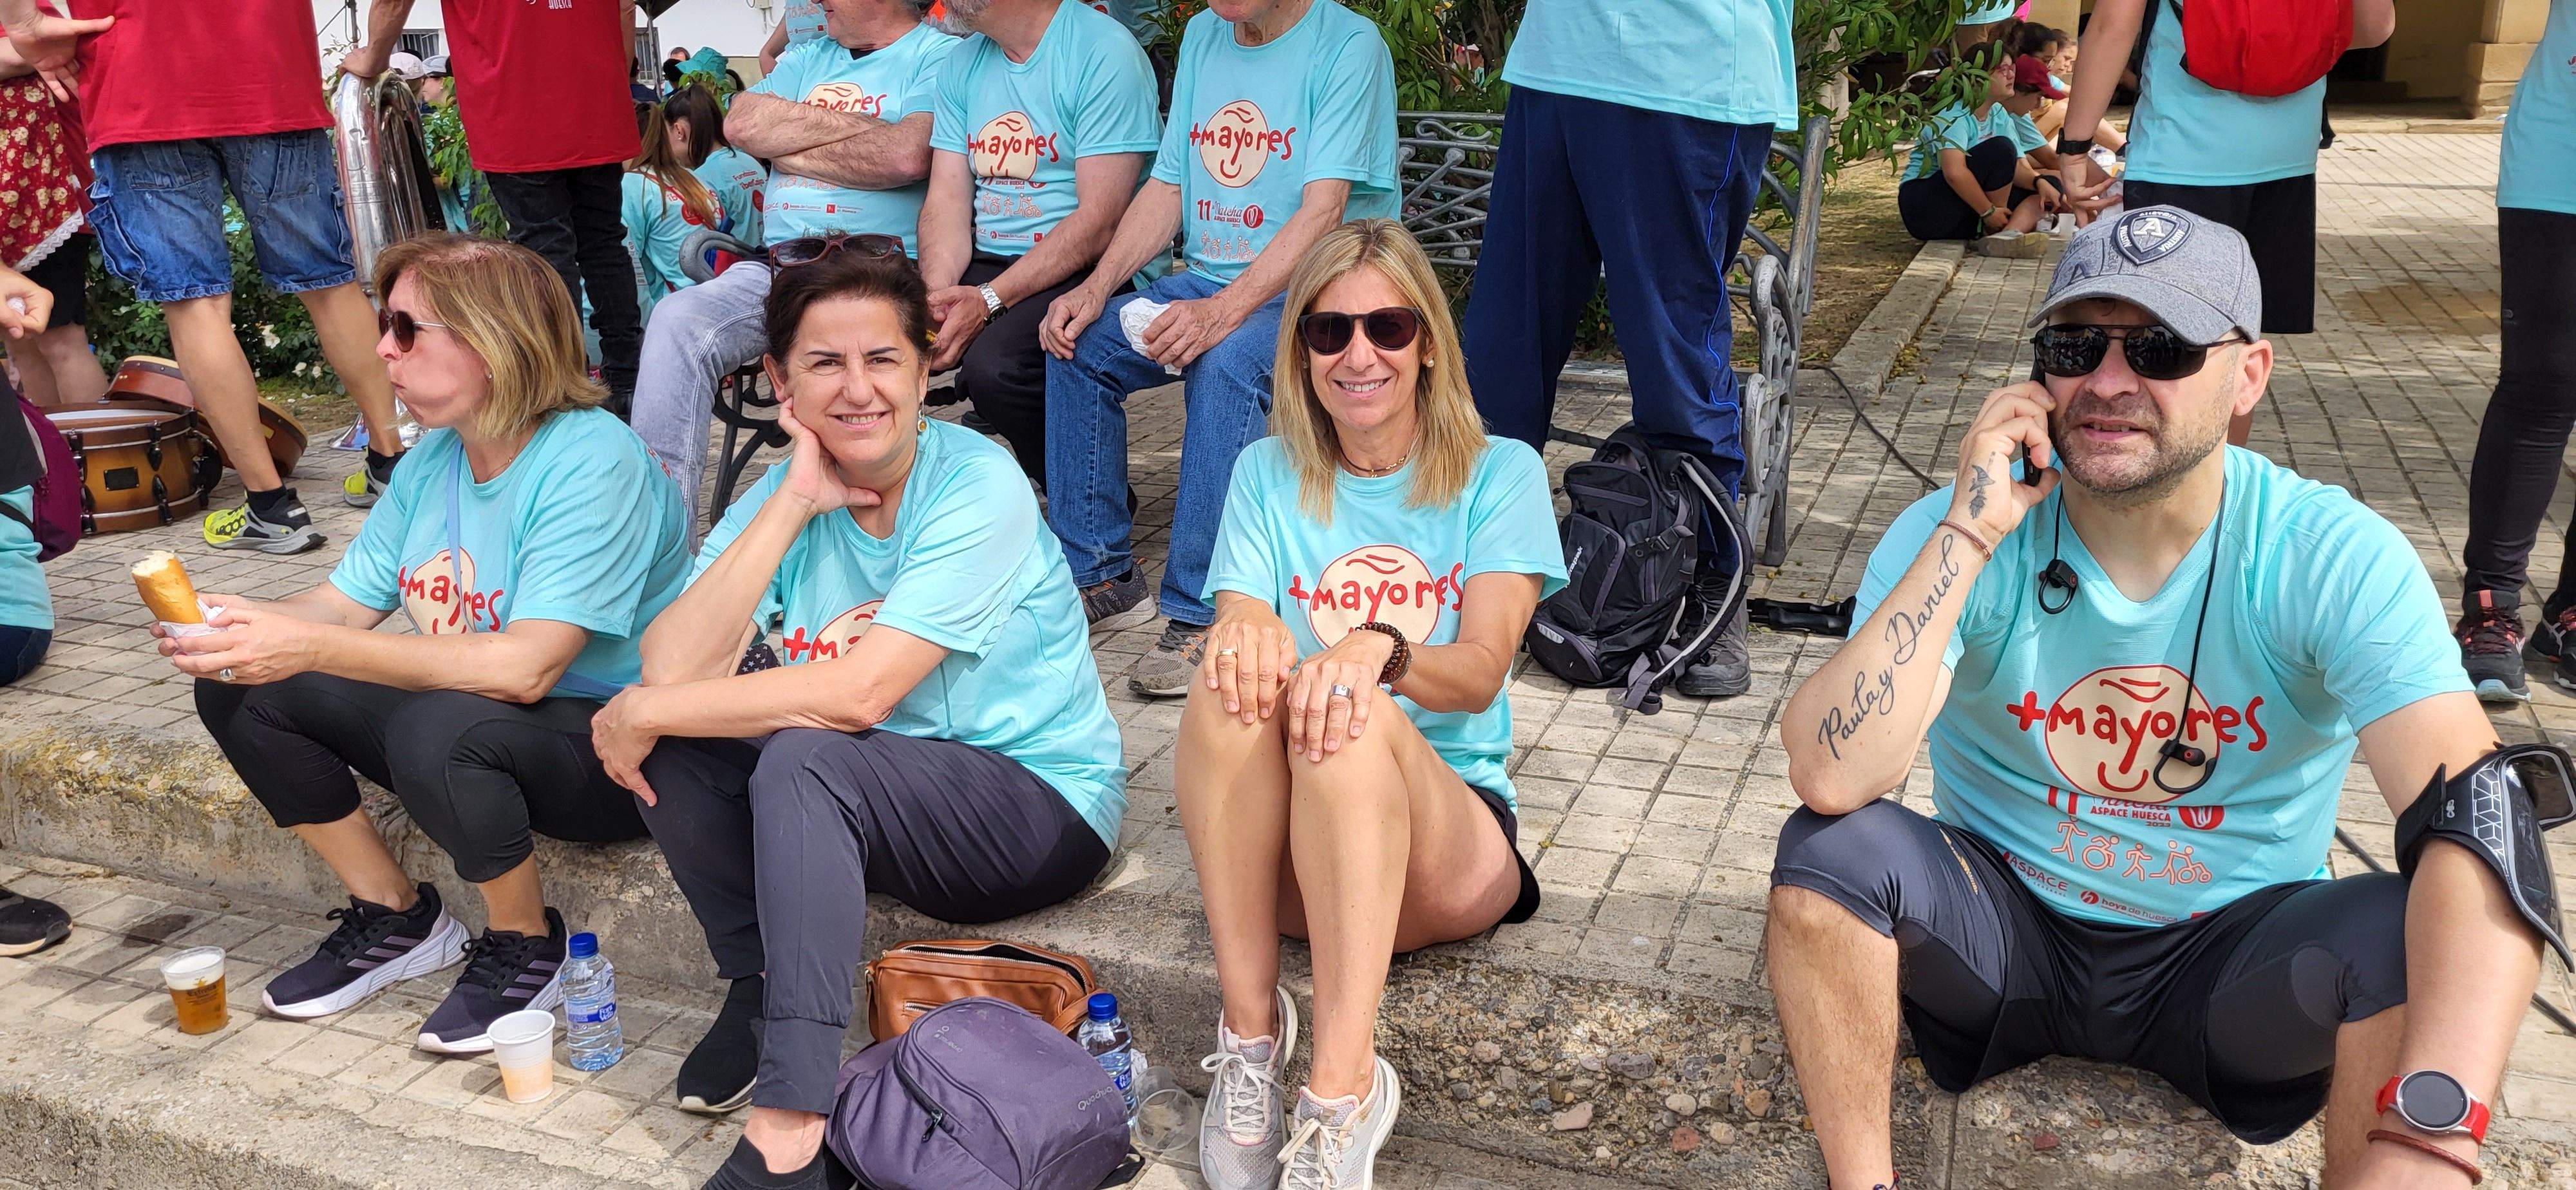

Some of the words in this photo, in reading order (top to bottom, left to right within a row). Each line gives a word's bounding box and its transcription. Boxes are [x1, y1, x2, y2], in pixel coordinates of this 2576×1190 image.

[1190, 122, 1296, 165] +mayores
[1197, 199, 1211, 221] 11
[399, 566, 504, 627] +mayres
[1288, 562, 1464, 623] +mayores
[1885, 534, 1959, 665] Daniel
[2006, 691, 2268, 775] +mayores
[2090, 806, 2128, 817] ASPACE
[2132, 811, 2171, 822] HUESCA
[2010, 856, 2069, 891] ASPACE
[2101, 898, 2126, 910] hoya
